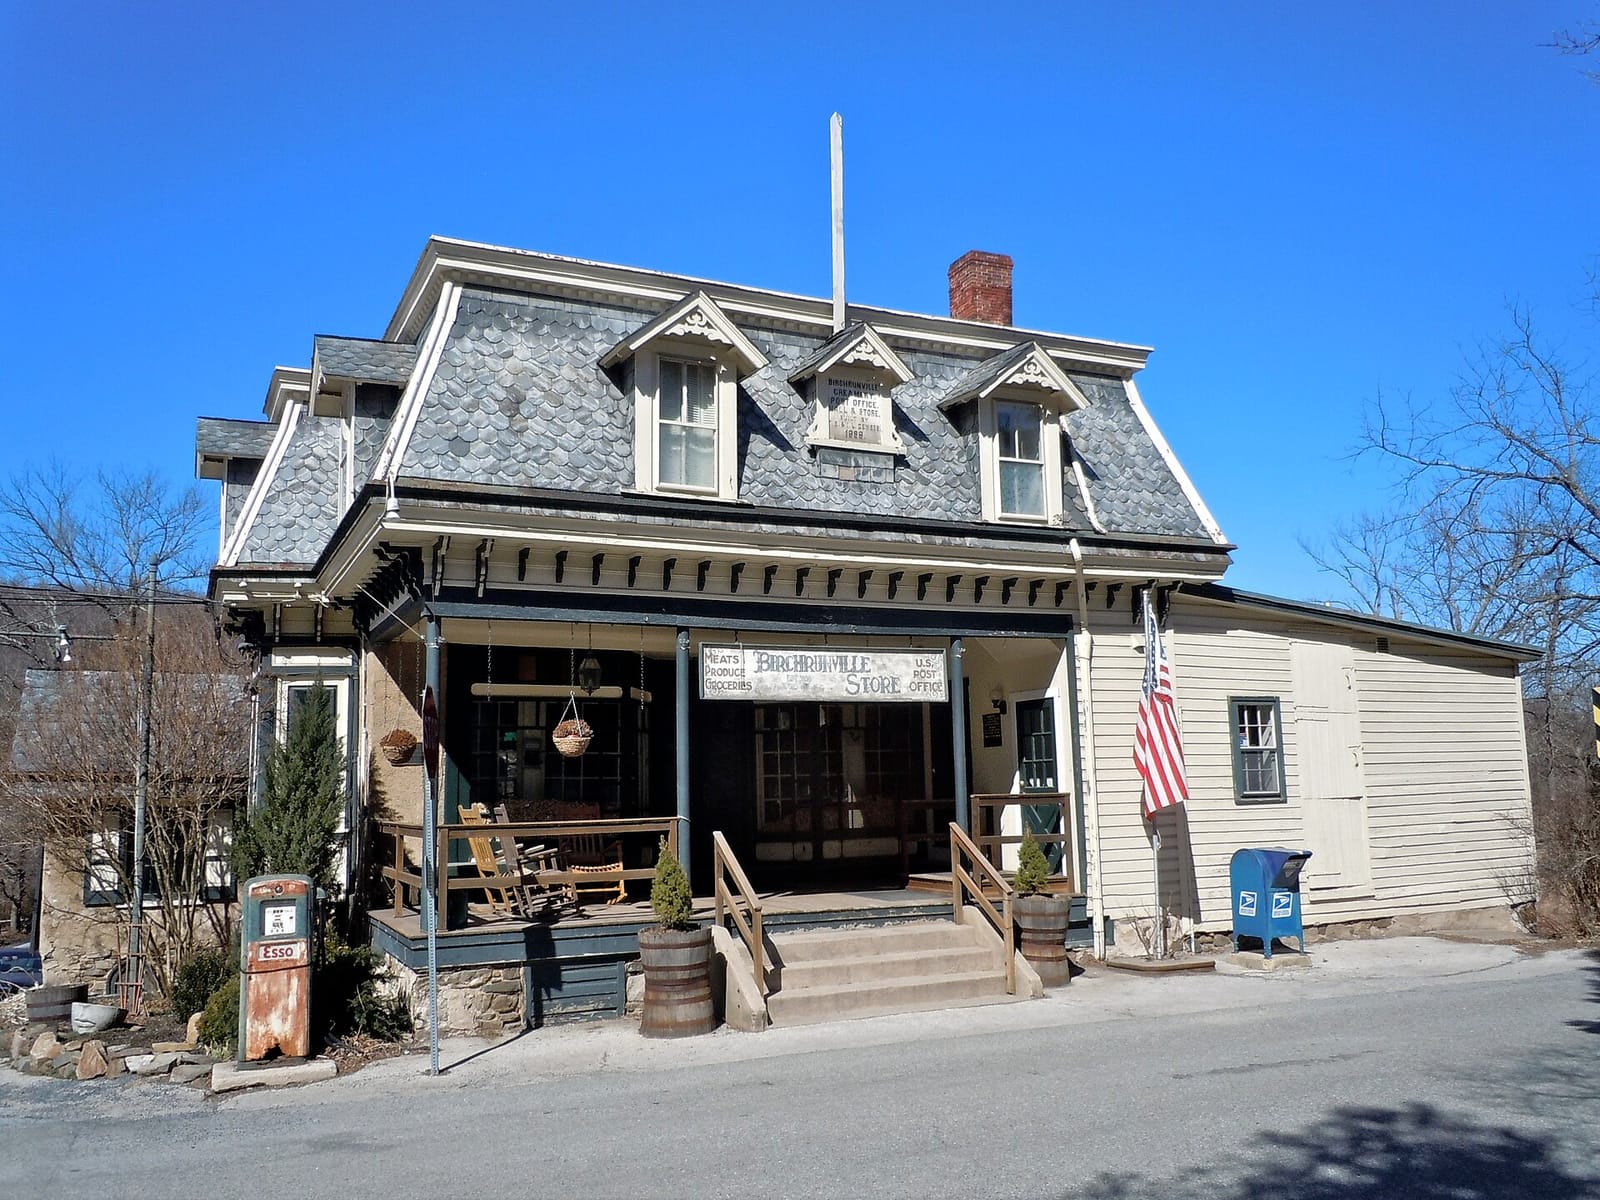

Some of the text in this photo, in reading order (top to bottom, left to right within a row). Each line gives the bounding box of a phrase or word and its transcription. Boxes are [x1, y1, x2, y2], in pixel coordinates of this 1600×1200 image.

[705, 652, 740, 664] MEATS
[753, 651, 871, 673] BIRCHRUNVILLE
[705, 665, 745, 677] PRODUCE
[913, 670, 936, 679] POST
[705, 678, 752, 690] GROCERIES
[845, 673, 901, 696] STORE
[909, 681, 943, 692] OFFICE
